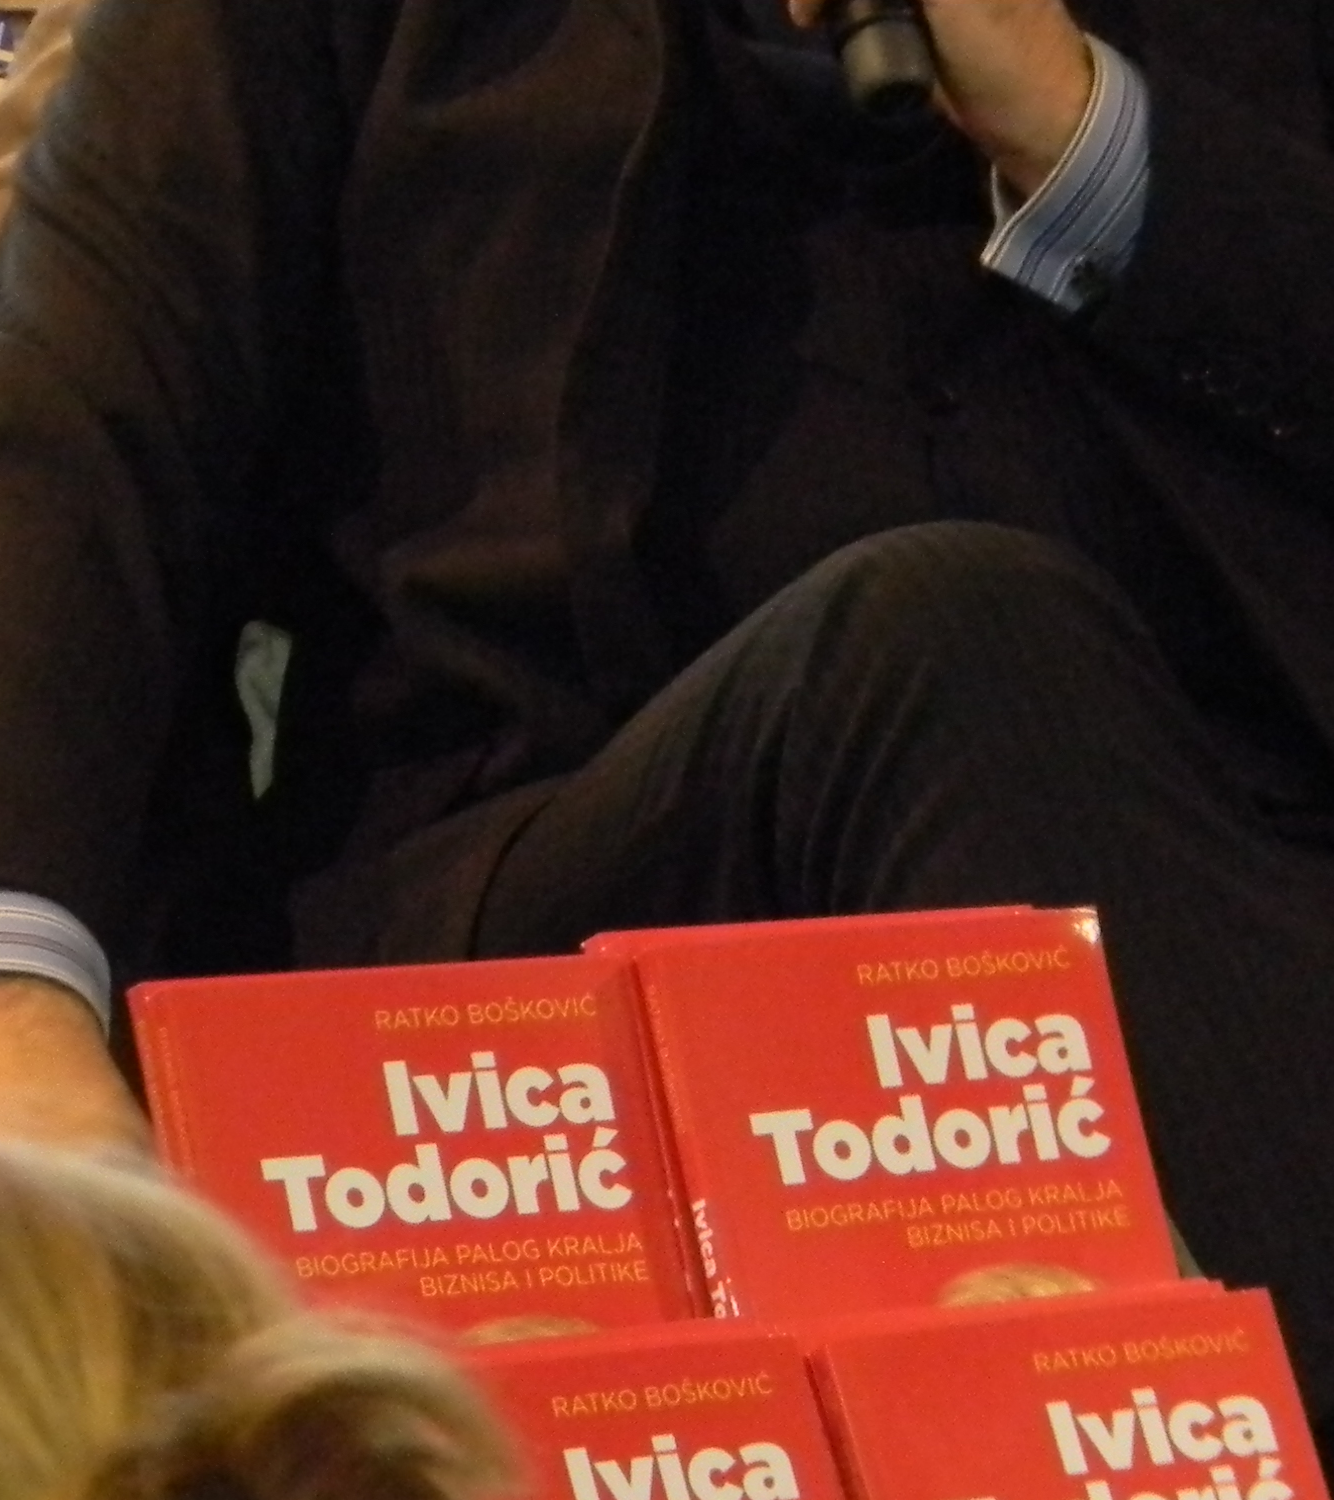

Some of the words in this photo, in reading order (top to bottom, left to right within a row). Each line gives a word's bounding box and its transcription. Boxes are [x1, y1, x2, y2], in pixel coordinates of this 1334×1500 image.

[857, 957, 940, 986] RATKO
[945, 945, 1071, 979] BOŠKOVIĆ
[374, 1003, 460, 1033] RATKO
[467, 993, 598, 1027] BOŠKOVIĆ
[866, 1002, 1092, 1089] Ivica
[382, 1050, 616, 1138] Ivica
[749, 1076, 1112, 1187] Todorić
[260, 1126, 634, 1233] Todorić
[785, 1197, 934, 1233] BIOGRAFIJA
[940, 1190, 1024, 1217] PALOG
[1028, 1179, 1123, 1209] KRALJA
[906, 1222, 1003, 1250] BIZNISA
[1022, 1207, 1131, 1236] POLITIKE
[295, 1247, 449, 1280] BIOGRAFIJA
[455, 1238, 540, 1264] PALOG
[546, 1230, 644, 1257] KRALJA
[419, 1272, 518, 1299] BIZNISA
[538, 1259, 650, 1289] POLITIKE
[1033, 1345, 1117, 1375] RATKO
[1121, 1328, 1250, 1365] BOŠKOVIĆ
[551, 1388, 638, 1418] RATKO
[644, 1370, 774, 1409] BOŠKOVIĆ
[1045, 1385, 1280, 1476] Ivica
[563, 1432, 801, 1500] Ivica
